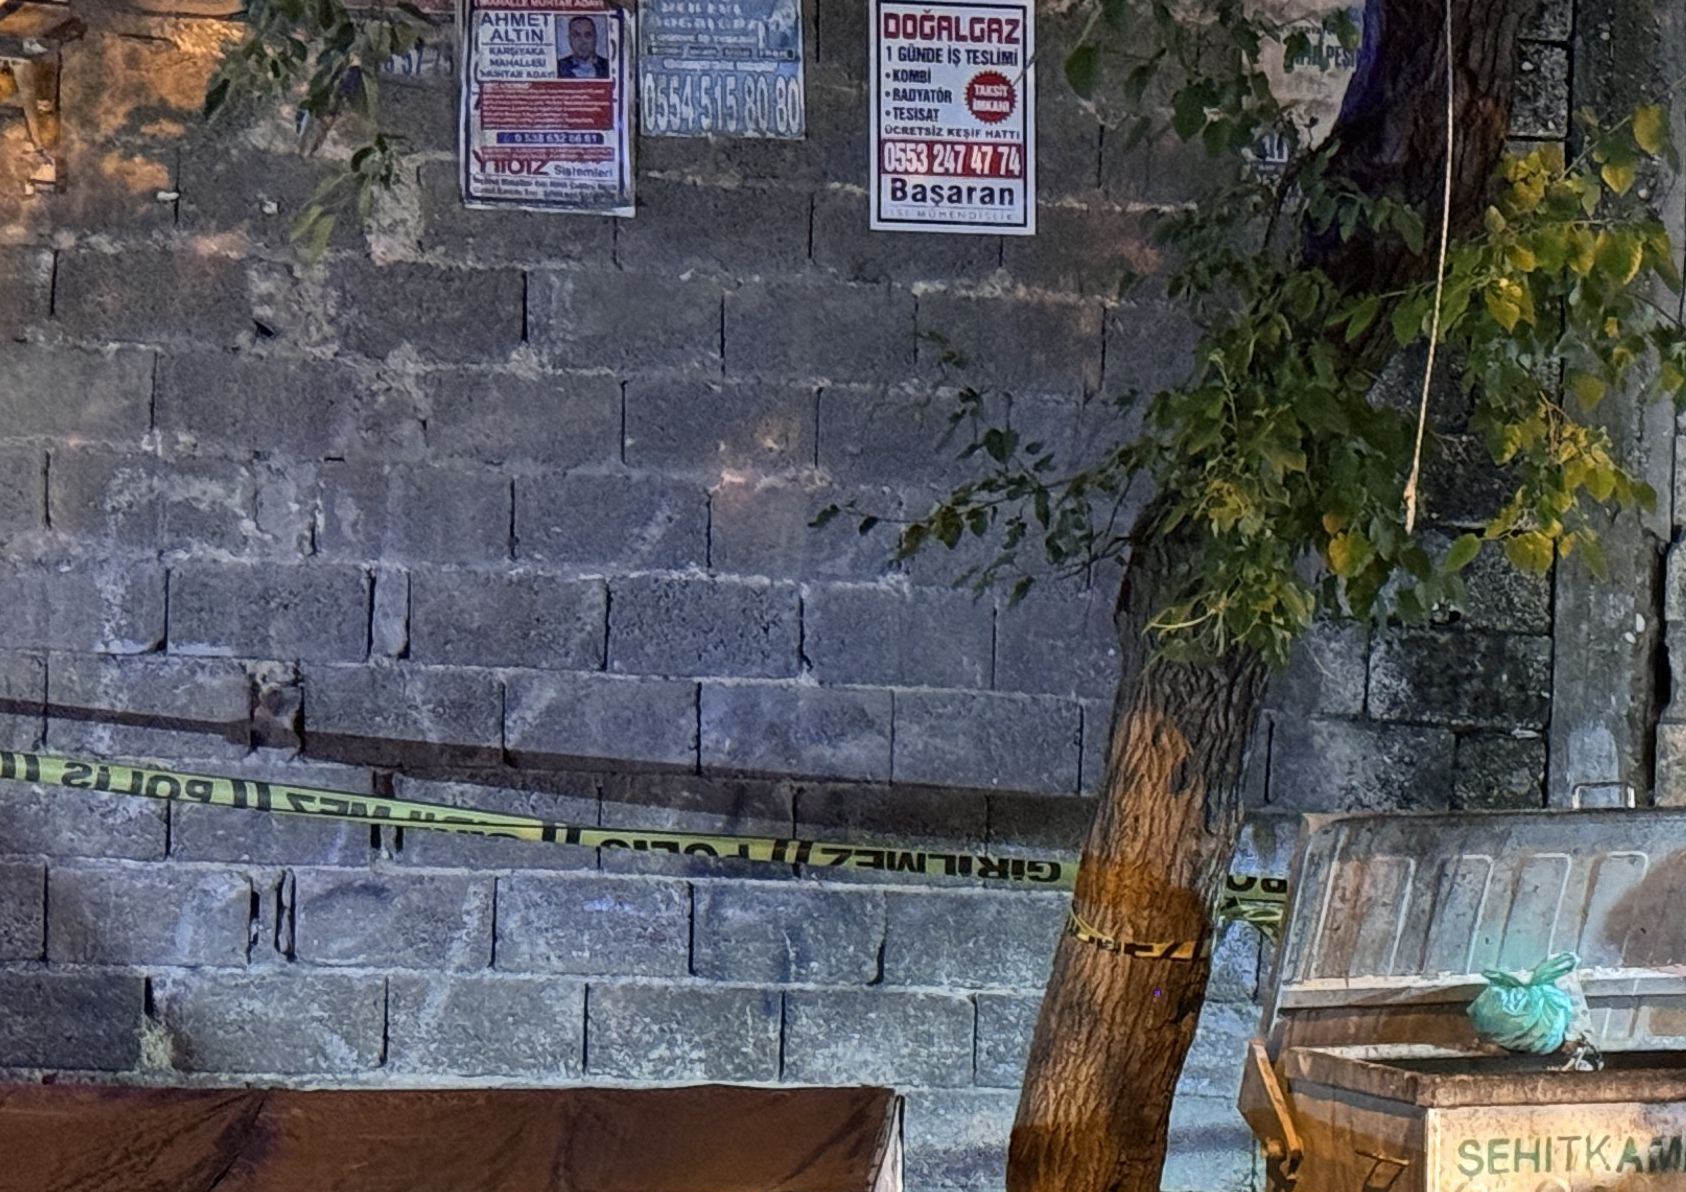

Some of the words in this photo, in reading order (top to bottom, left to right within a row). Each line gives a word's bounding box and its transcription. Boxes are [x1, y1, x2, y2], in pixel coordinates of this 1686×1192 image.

[481, 12, 553, 27] AHMET
[883, 9, 1020, 44] DOĞALGAZ
[490, 29, 544, 42] ALTIN
[886, 46, 892, 61] 1
[898, 44, 943, 63] GÜNDE
[948, 45, 961, 67] İŞ
[644, 73, 694, 131] 0554
[701, 75, 738, 132] 515
[744, 75, 769, 134] 80
[775, 76, 800, 134] 80
[884, 125, 943, 137] ÜCRETSİZ
[985, 130, 1020, 140] HATTI
[884, 142, 928, 173] 0553
[932, 143, 965, 175] 247
[971, 145, 992, 175] 47
[998, 146, 1020, 175] 74
[891, 178, 1014, 206] Başaran
